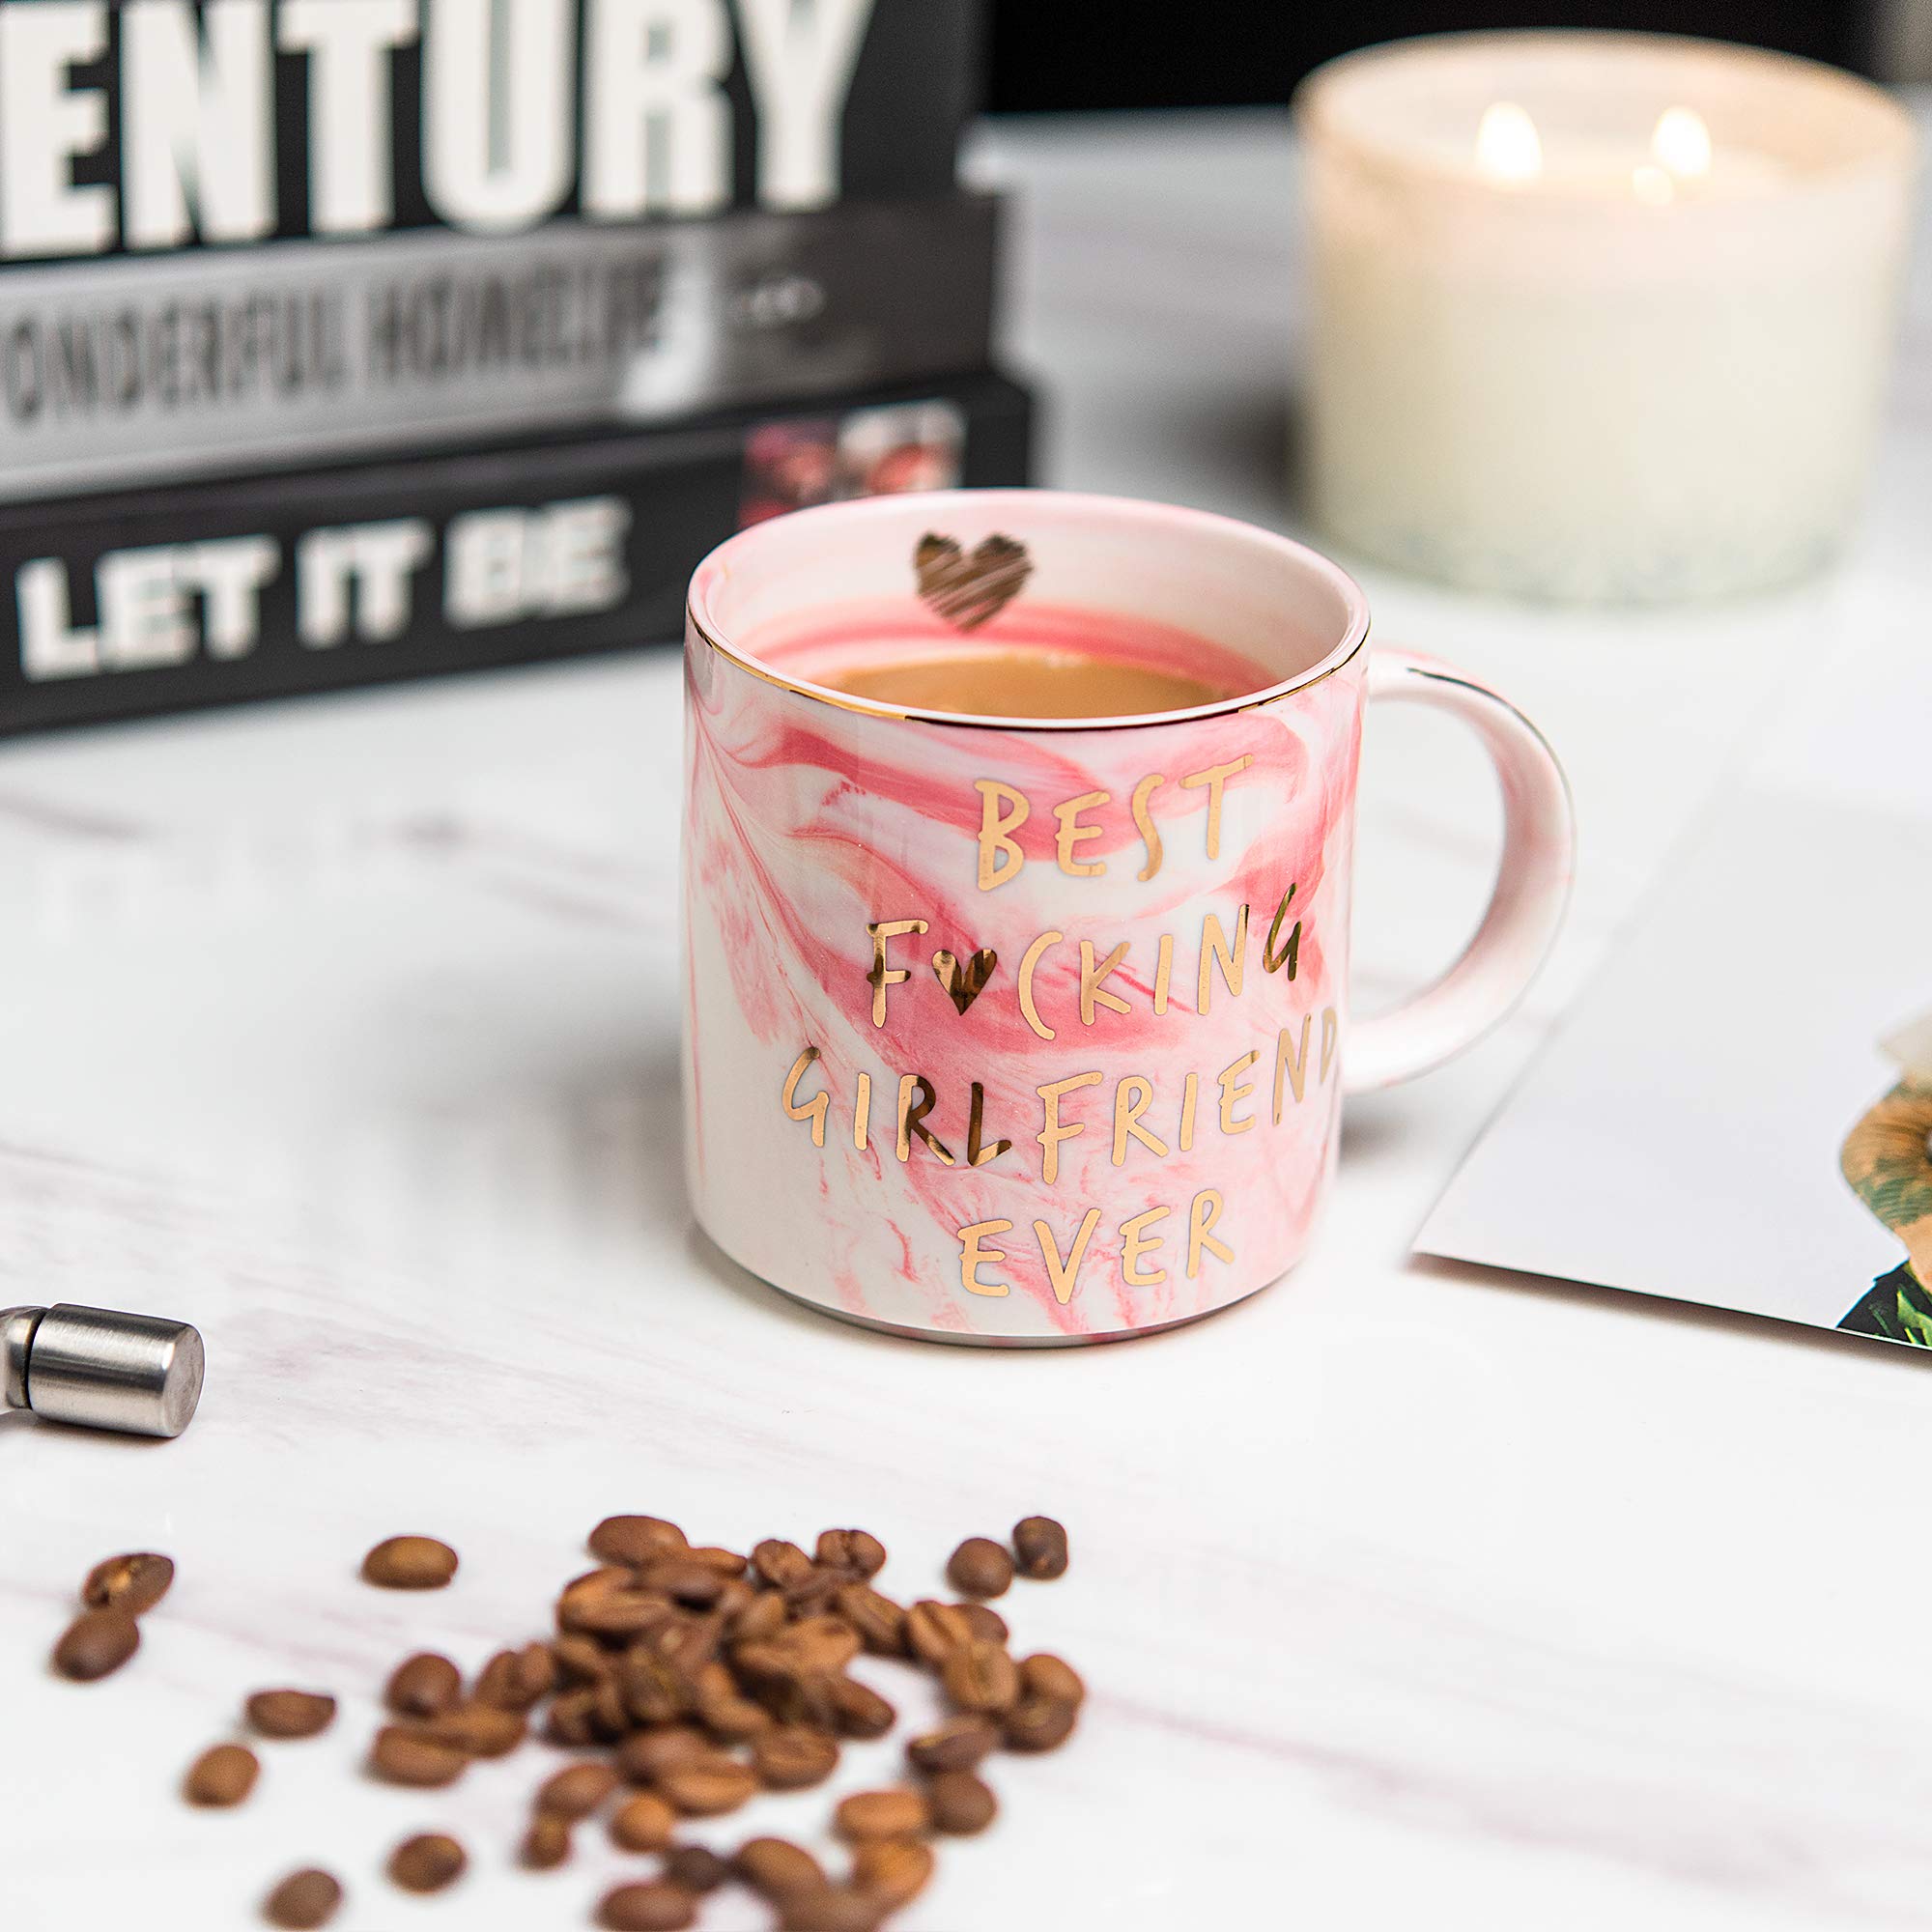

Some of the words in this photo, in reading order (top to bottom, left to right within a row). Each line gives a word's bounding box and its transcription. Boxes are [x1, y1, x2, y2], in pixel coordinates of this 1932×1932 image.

[15, 533, 282, 682] LET
[296, 516, 436, 650] IT
[441, 494, 633, 632] BE
[974, 753, 1254, 892] BEST
[781, 1007, 1338, 1185] GIRLFRIEND
[956, 1188, 1236, 1305] EVER
